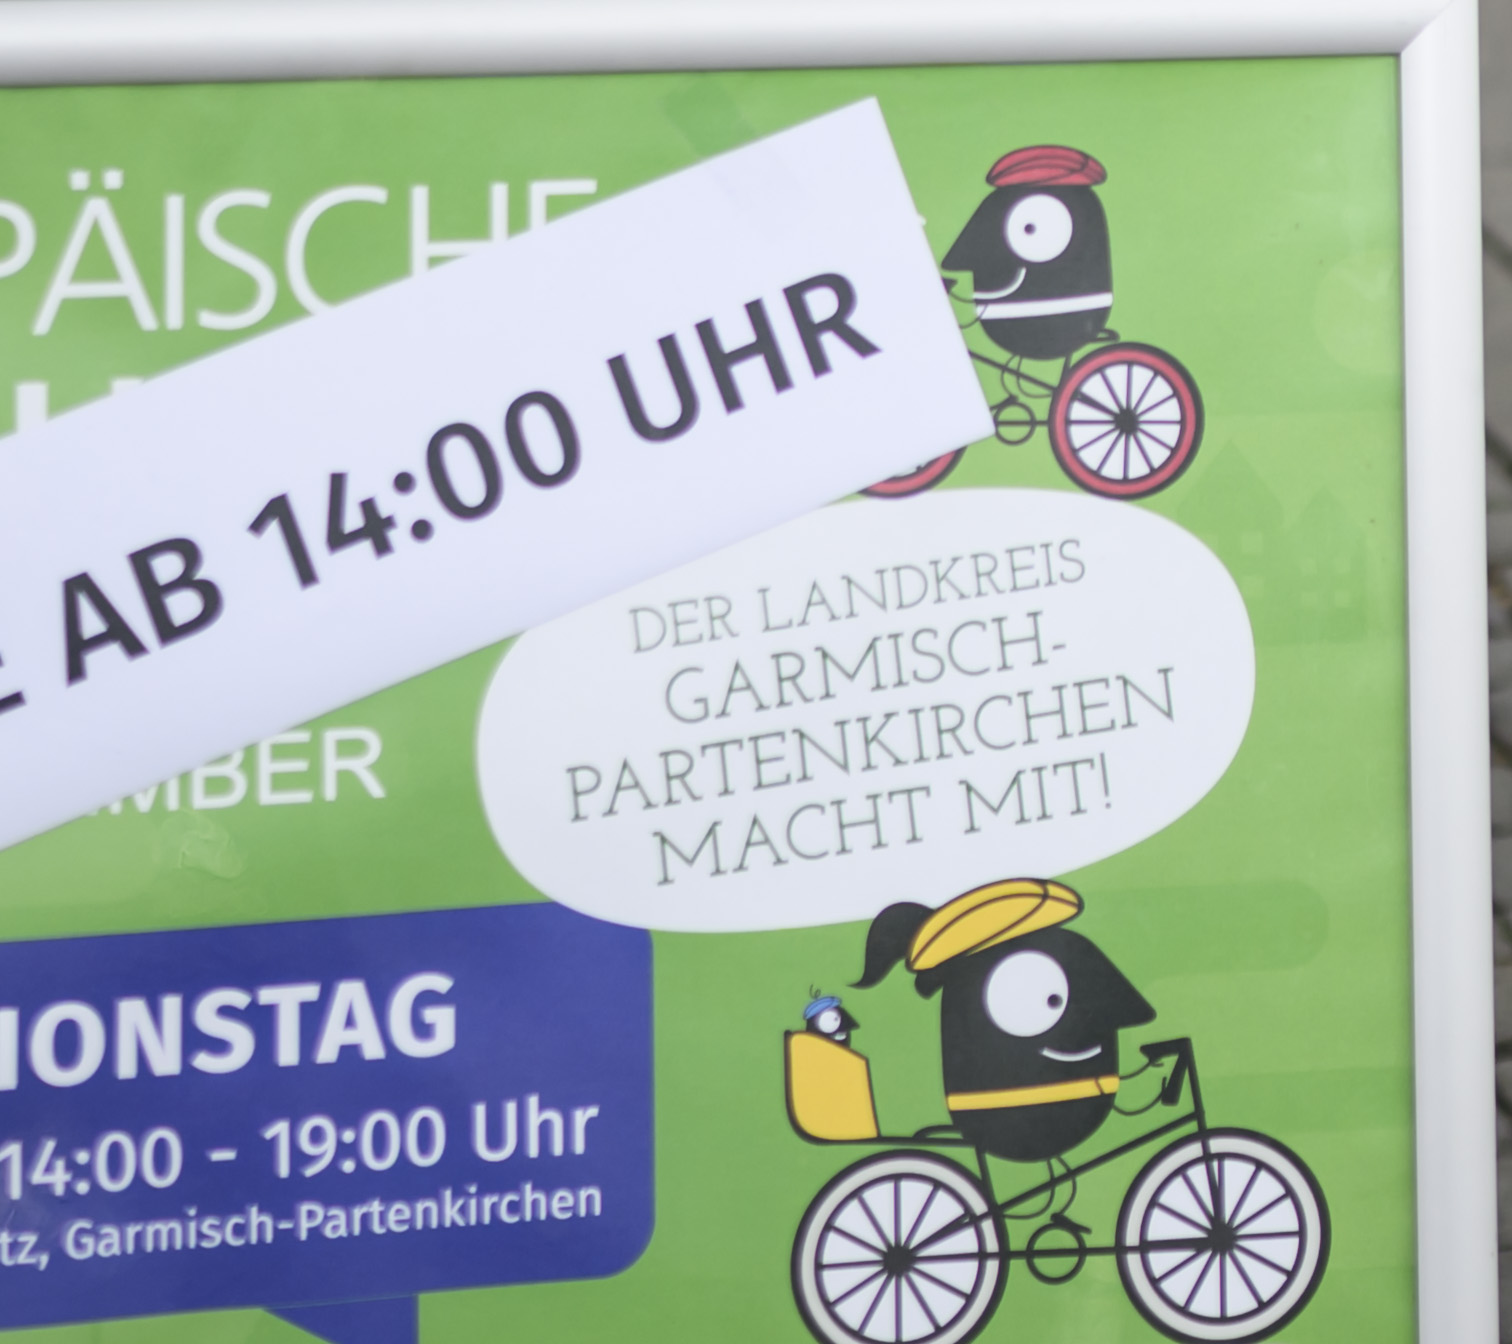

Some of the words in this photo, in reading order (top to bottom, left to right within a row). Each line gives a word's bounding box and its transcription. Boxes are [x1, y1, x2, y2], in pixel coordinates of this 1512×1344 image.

[64, 538, 222, 685] AB
[248, 391, 580, 588] 14:00
[607, 273, 880, 442] UHR
[629, 595, 739, 653] DER
[758, 539, 1085, 632] LANDKREIS
[666, 611, 1068, 723] GARMISCH-
[566, 668, 1173, 822] PARTENKIRCHEN
[653, 786, 922, 886] MACHT
[959, 753, 1111, 834] MIT!
[263, 1108, 448, 1181] 19:00
[474, 1095, 599, 1161] Uhr
[64, 1182, 601, 1259] Garmisch-Partenkirchen
